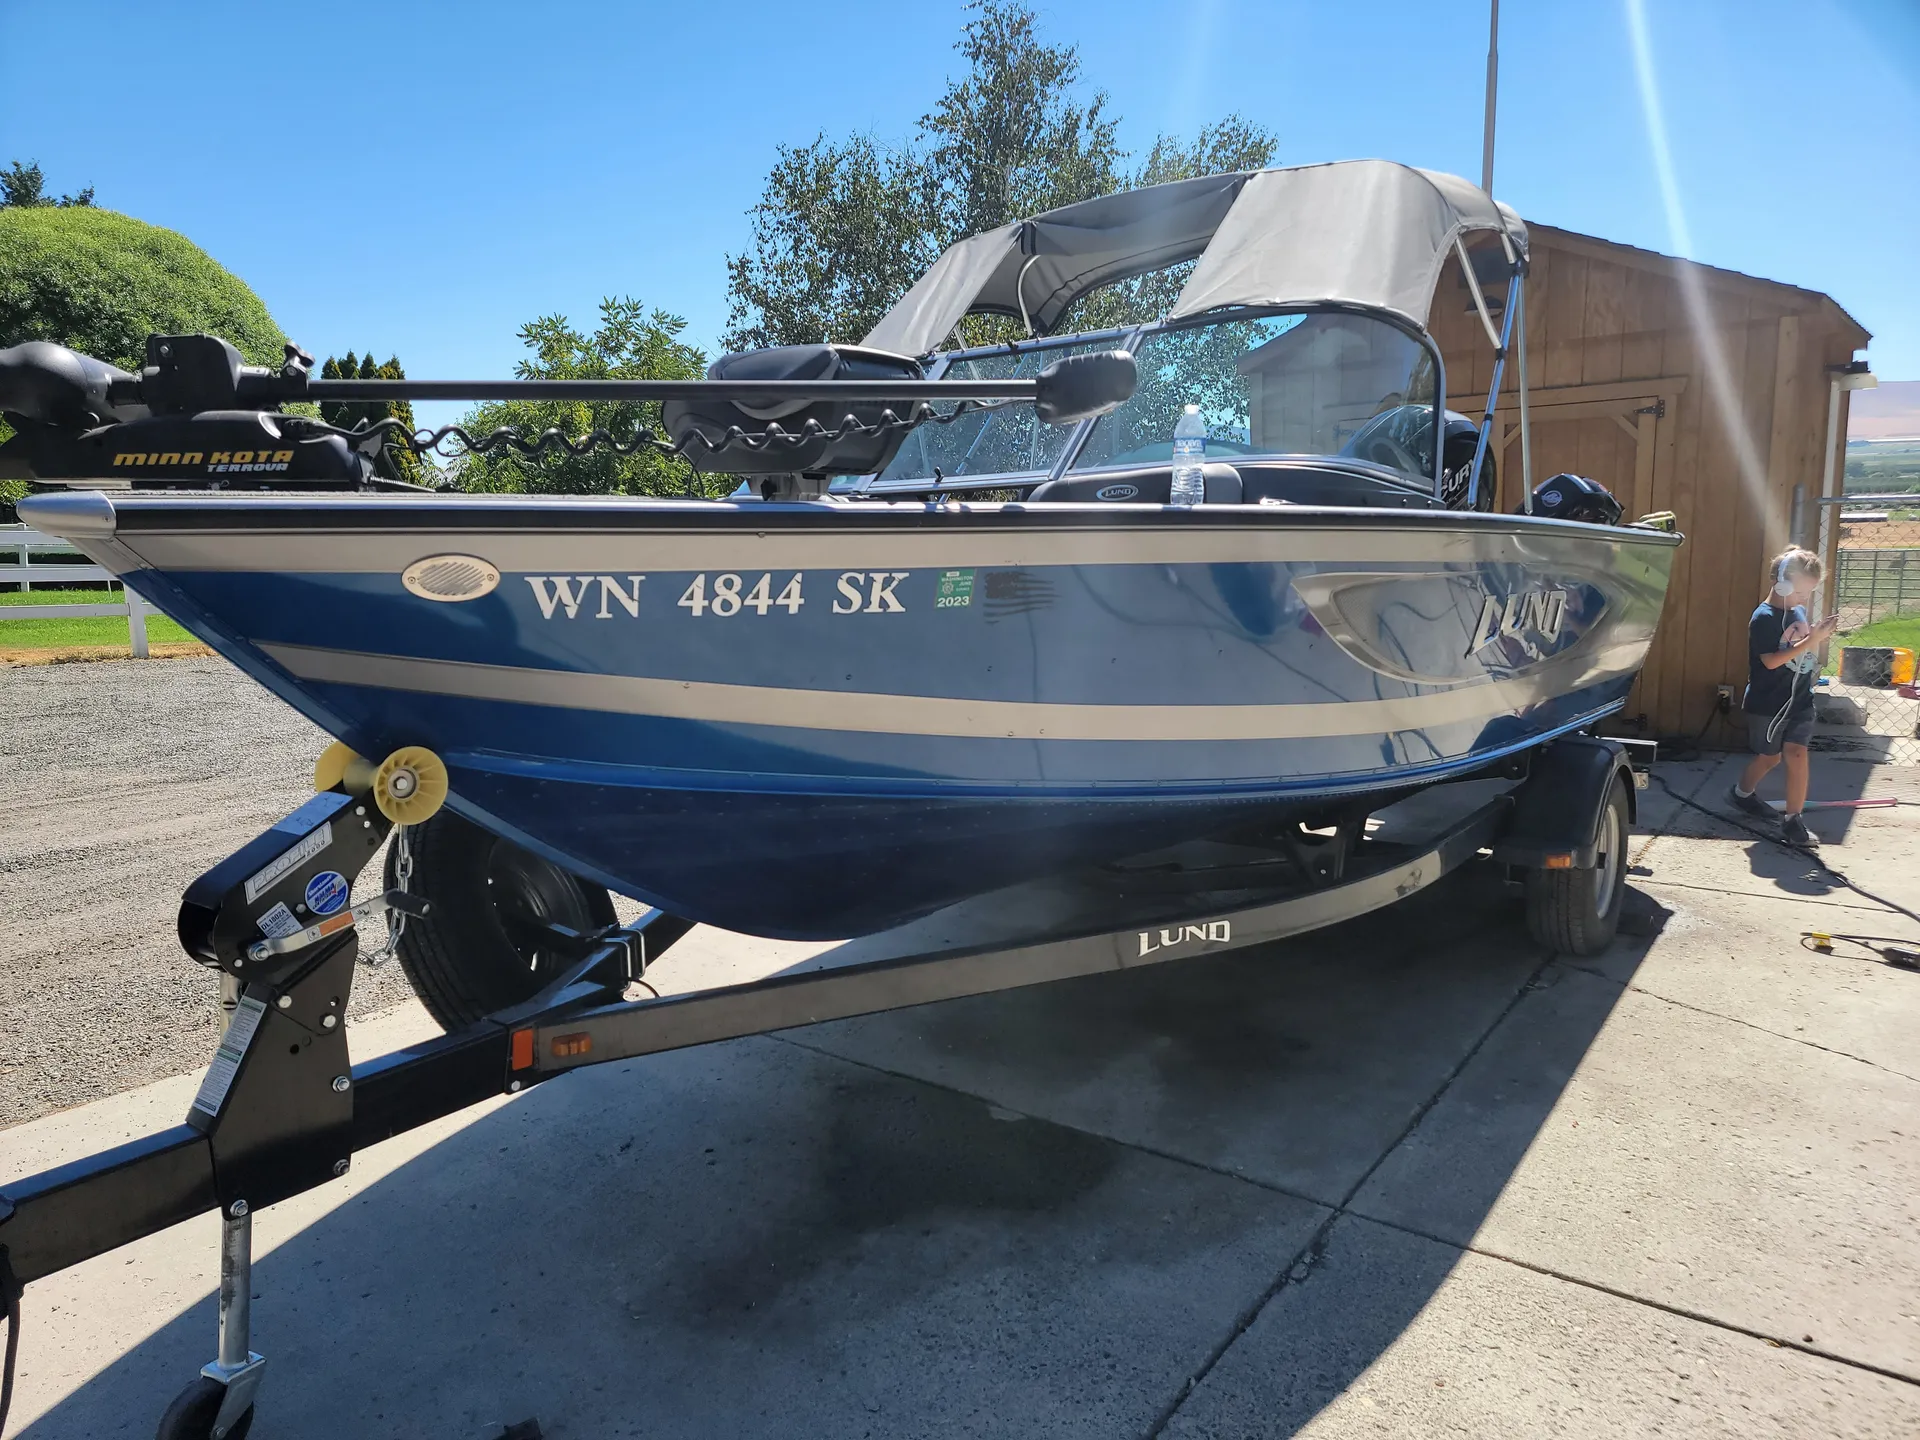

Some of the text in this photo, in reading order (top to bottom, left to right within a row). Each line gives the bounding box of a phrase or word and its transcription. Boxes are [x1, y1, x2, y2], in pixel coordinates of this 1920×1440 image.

[113, 450, 295, 466] MINN KOTA
[207, 463, 289, 473] TERROVA
[1105, 488, 1131, 497] LUND
[524, 571, 910, 619] WN 4844 SK
[937, 596, 969, 607] 2023
[1464, 590, 1566, 659] LUND
[252, 828, 325, 891] PROFILE
[1138, 920, 1231, 957] LUND
